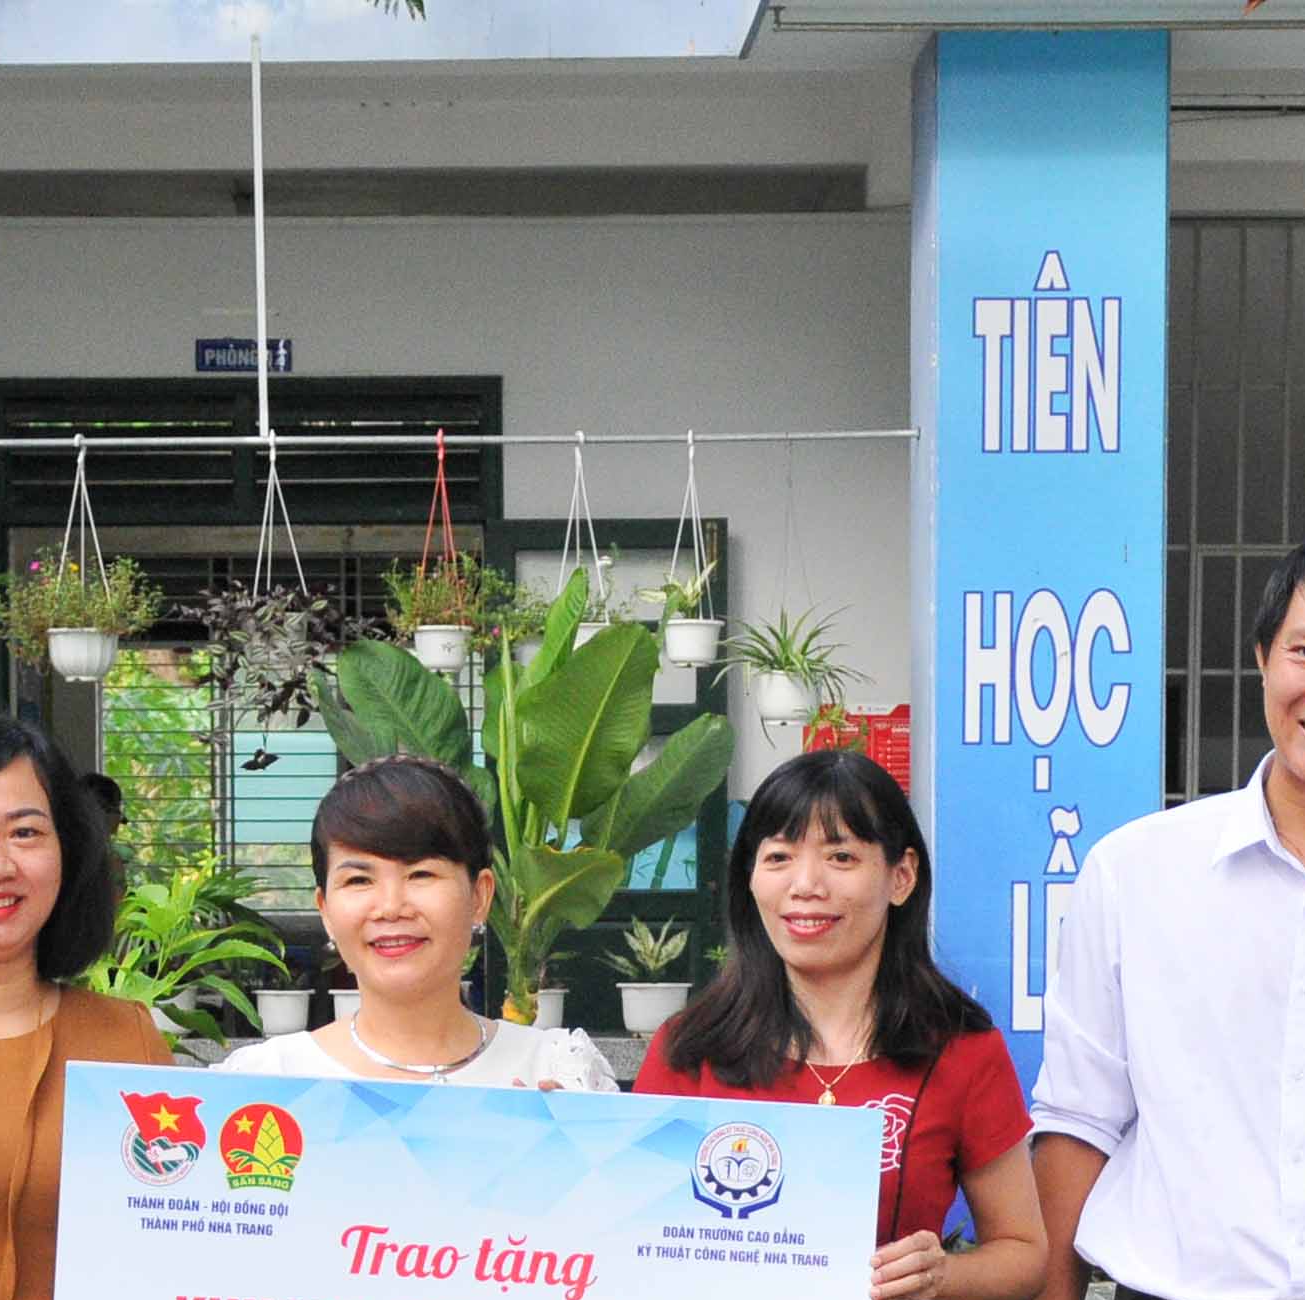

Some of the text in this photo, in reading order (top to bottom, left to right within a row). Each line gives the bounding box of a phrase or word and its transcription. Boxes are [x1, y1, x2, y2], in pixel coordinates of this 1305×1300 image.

[973, 250, 1122, 453] TIÊN
[962, 587, 1133, 793] HỌC
[127, 1195, 165, 1210] THÀNH
[168, 1197, 200, 1211] ĐOÀN
[211, 1199, 231, 1215] HỘI
[141, 1217, 273, 1237] THÀNH PHỐ NHA TRANG
[663, 1224, 695, 1240] ĐOÀN
[698, 1226, 744, 1243] TRƯỜNG
[747, 1230, 770, 1245] CAO
[341, 1225, 469, 1280] Trao
[655, 1246, 692, 1262] THUẬT
[695, 1246, 726, 1262] CÔNG
[729, 1249, 760, 1267] NGHỆ
[763, 1253, 788, 1265] NHA
[791, 1253, 829, 1267] TRANG
